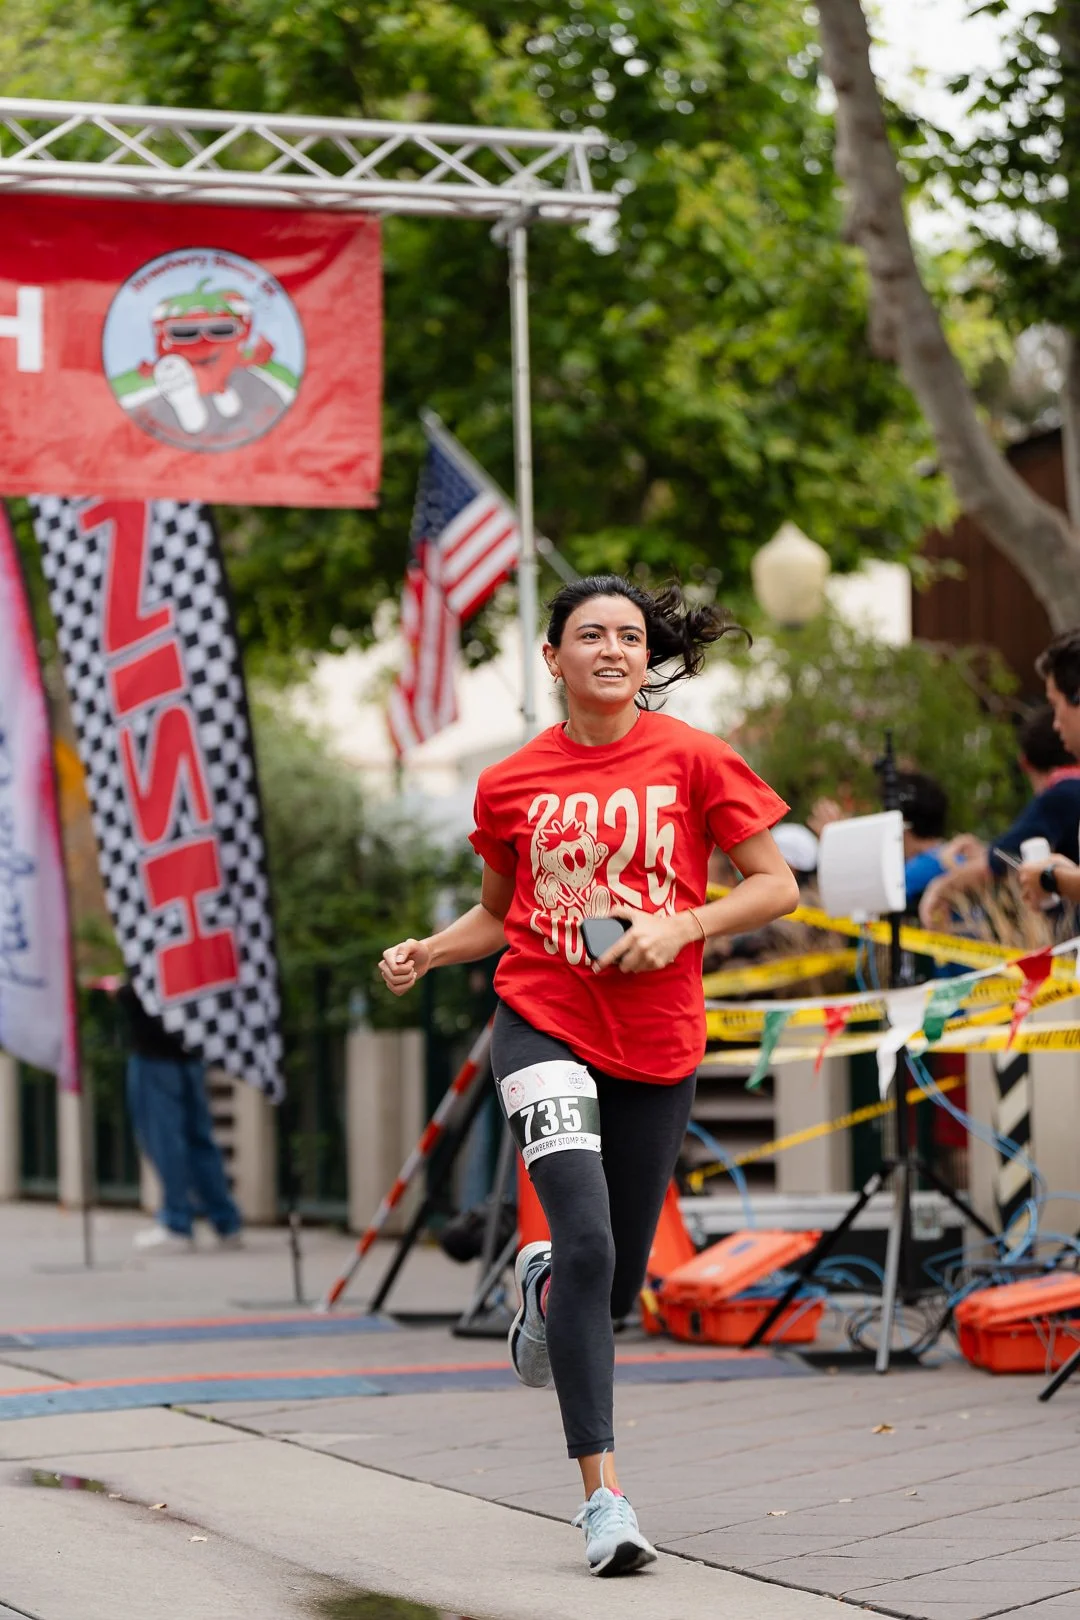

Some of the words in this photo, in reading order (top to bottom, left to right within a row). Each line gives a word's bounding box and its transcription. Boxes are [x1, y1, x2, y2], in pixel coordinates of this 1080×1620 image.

[527, 784, 678, 909] 2025
[519, 1097, 583, 1145] 735
[525, 1138, 558, 1158] STRAWBERRY
[558, 1136, 579, 1146] STOMP
[580, 1136, 588, 1144] 5K
